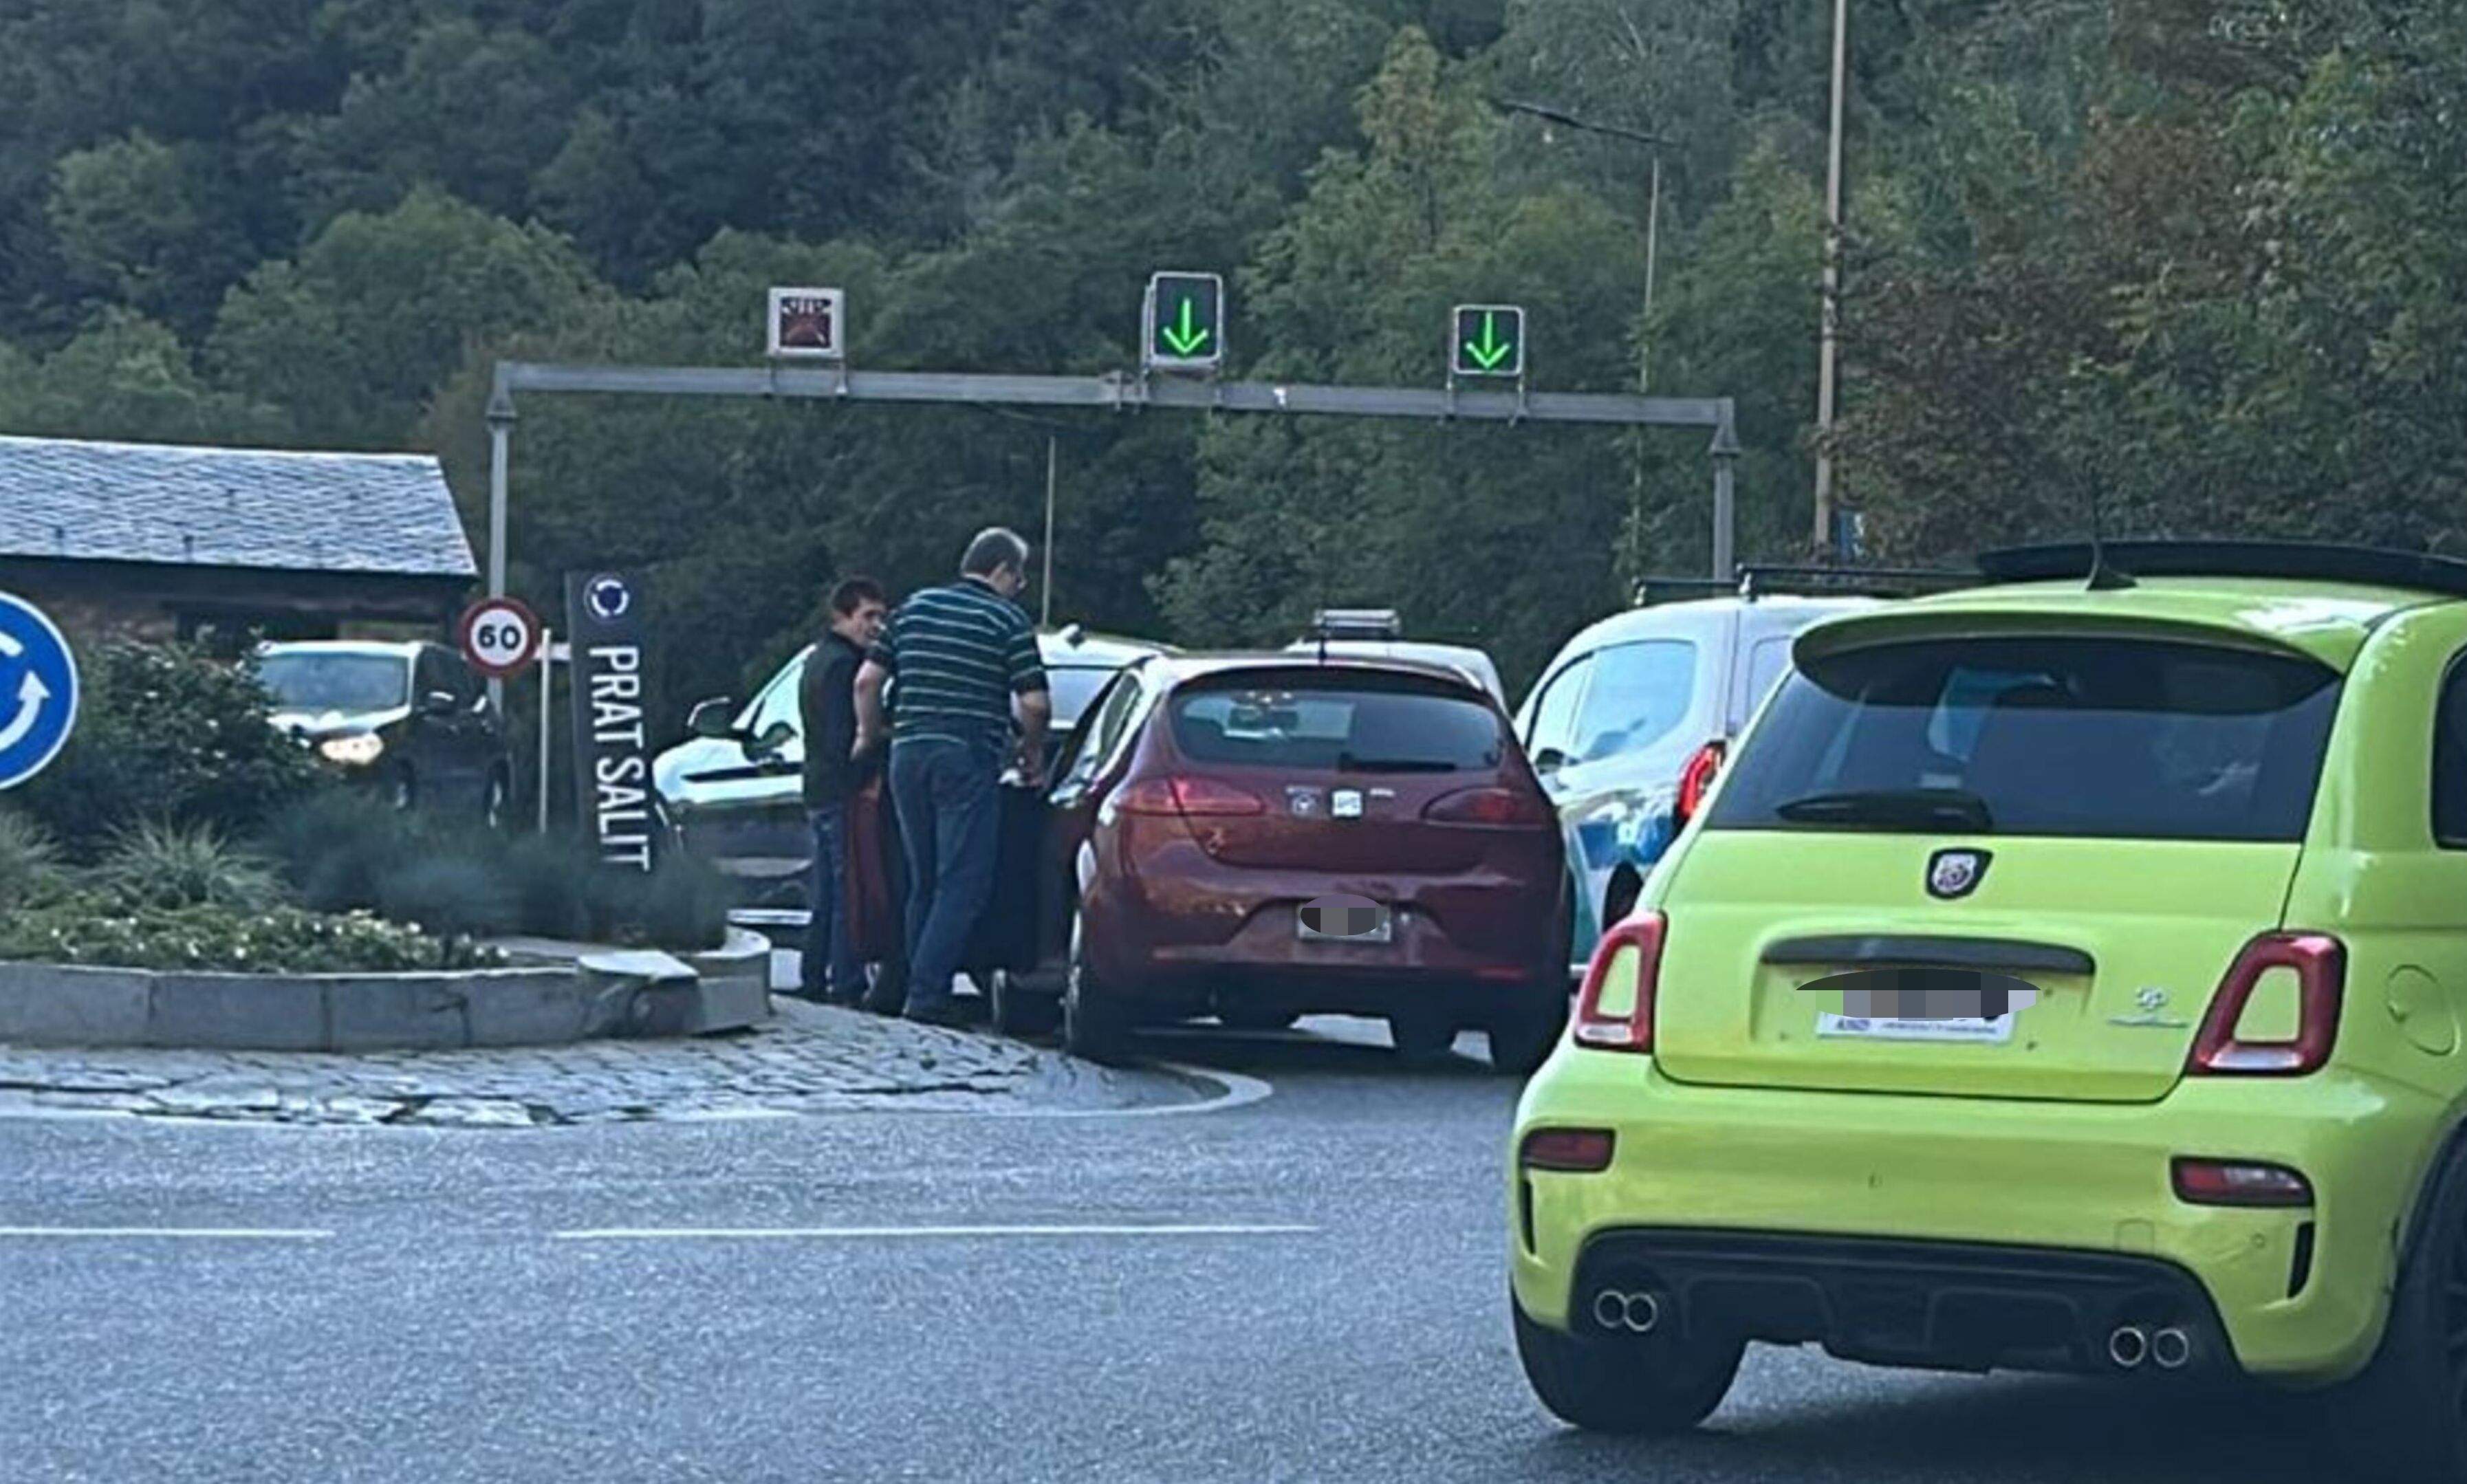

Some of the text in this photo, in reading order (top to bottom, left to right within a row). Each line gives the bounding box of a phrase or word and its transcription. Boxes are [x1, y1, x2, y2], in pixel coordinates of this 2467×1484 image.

[477, 624, 521, 649] 60
[589, 645, 650, 873] PRAT SALIT
